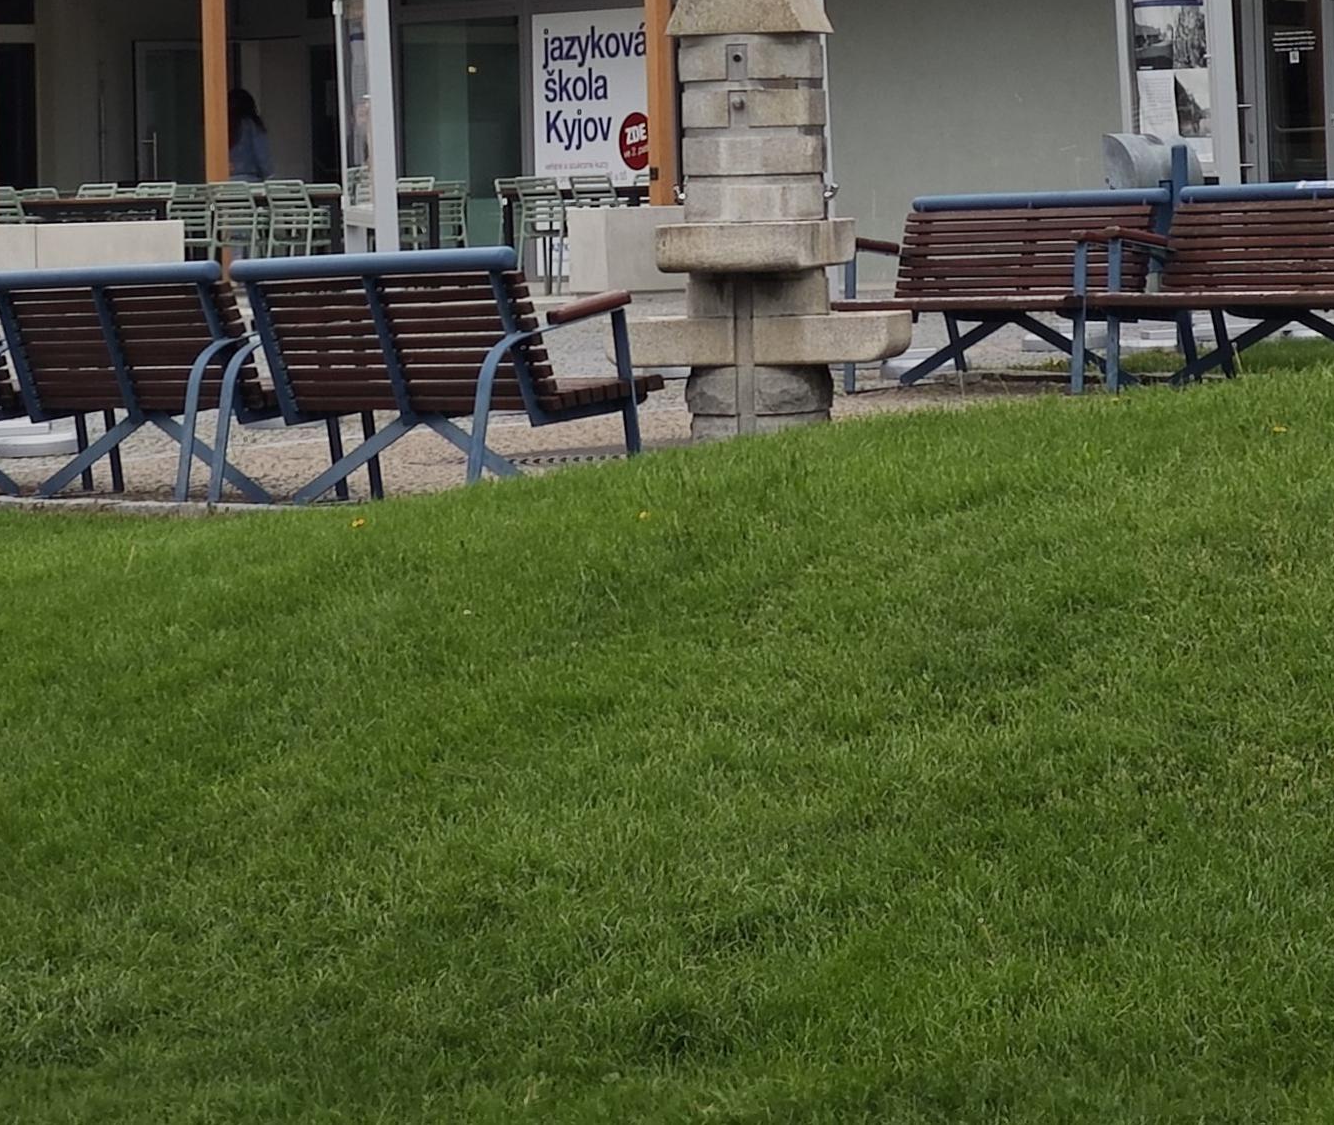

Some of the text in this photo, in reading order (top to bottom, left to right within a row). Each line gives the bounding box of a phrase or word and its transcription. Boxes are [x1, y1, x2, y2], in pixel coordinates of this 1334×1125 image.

[542, 22, 647, 70] jazyková
[544, 67, 608, 103] škola
[545, 108, 612, 151] Kyjov
[624, 122, 647, 146] ZDE
